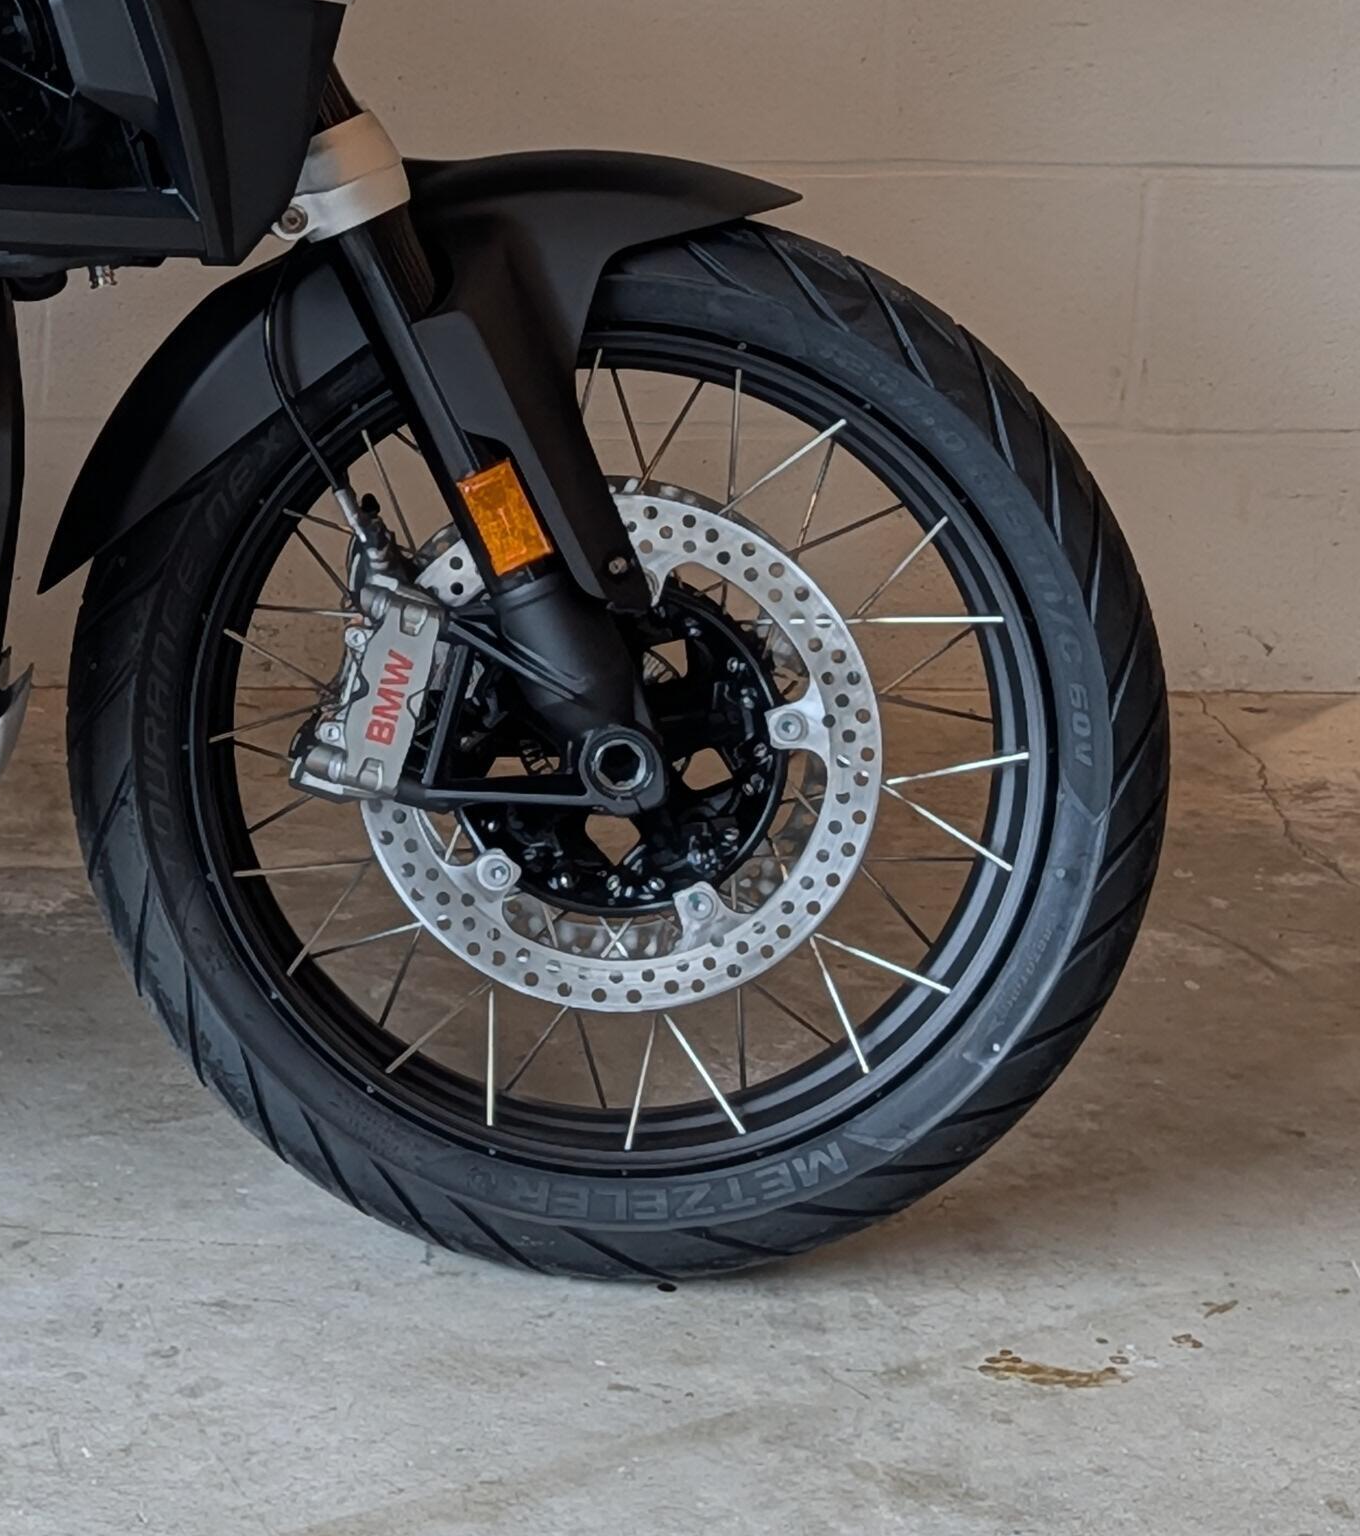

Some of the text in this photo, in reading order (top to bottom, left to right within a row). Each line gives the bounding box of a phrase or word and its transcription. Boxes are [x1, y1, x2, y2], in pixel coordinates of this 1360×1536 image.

[204, 414, 292, 540] NEX
[365, 649, 414, 745] BMW
[1068, 681, 1094, 767] 60V
[508, 1141, 850, 1221] METZELER
